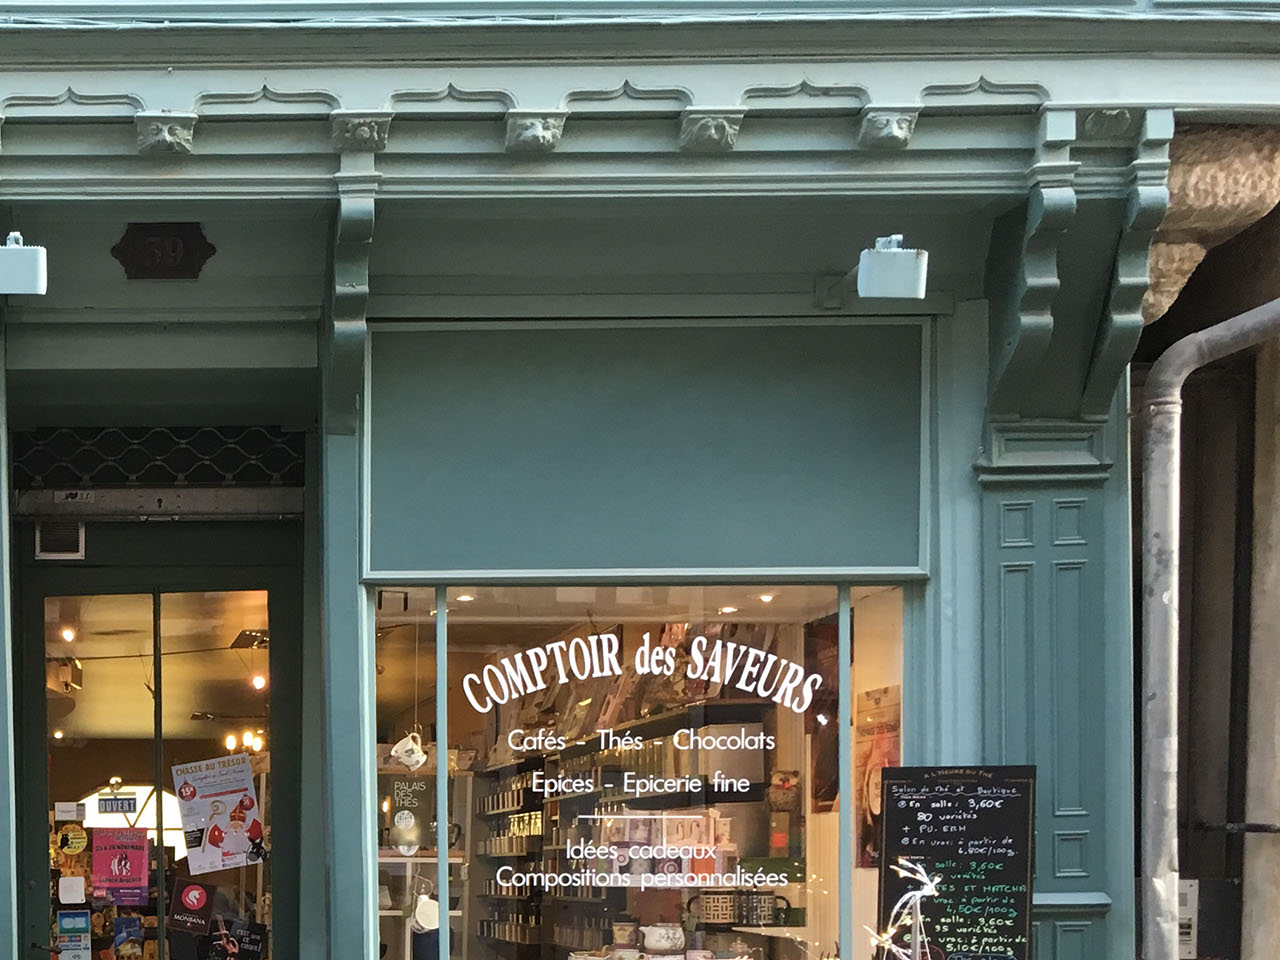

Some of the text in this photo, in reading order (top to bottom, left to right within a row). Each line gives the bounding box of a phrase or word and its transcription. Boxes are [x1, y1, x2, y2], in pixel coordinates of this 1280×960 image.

[462, 633, 823, 714] COMPTOIR des SAVEURS
[508, 729, 566, 751] Cafés
[597, 729, 643, 751] Thés
[673, 729, 776, 751] Chocolats
[175, 766, 203, 776] CHASSE
[205, 763, 216, 772] AU
[394, 781, 426, 791] PALAIS
[532, 772, 594, 797] Epices
[623, 772, 702, 797] Epicerie
[713, 771, 750, 792] fine
[394, 790, 413, 799] DES
[100, 800, 135, 811] OUVERT
[566, 838, 717, 859] Idées cadeaux
[496, 866, 788, 891] Compositions personnalisées
[174, 914, 206, 926] MONBANA
